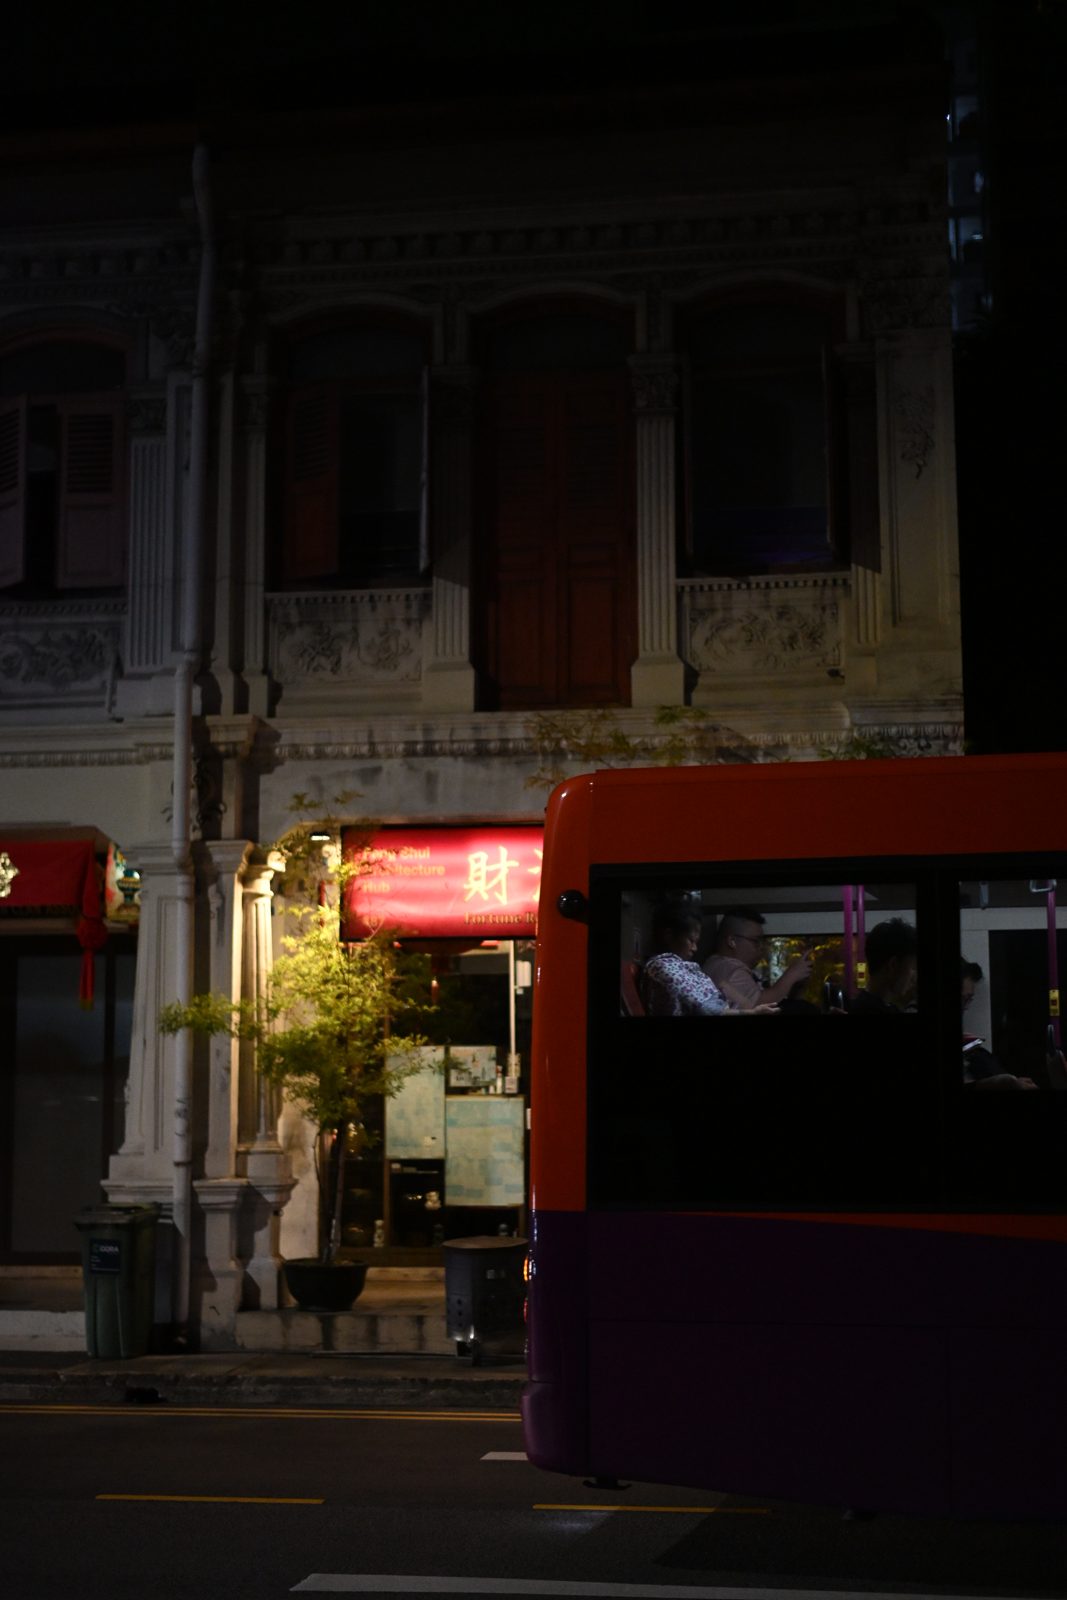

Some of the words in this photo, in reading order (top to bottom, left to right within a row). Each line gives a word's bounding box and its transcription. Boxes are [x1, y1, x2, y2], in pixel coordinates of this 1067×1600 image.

[363, 847, 396, 862] Feng
[400, 846, 430, 859] Shui
[464, 846, 543, 905] 財
[362, 878, 390, 892] Hub
[464, 911, 522, 924] Fortune
